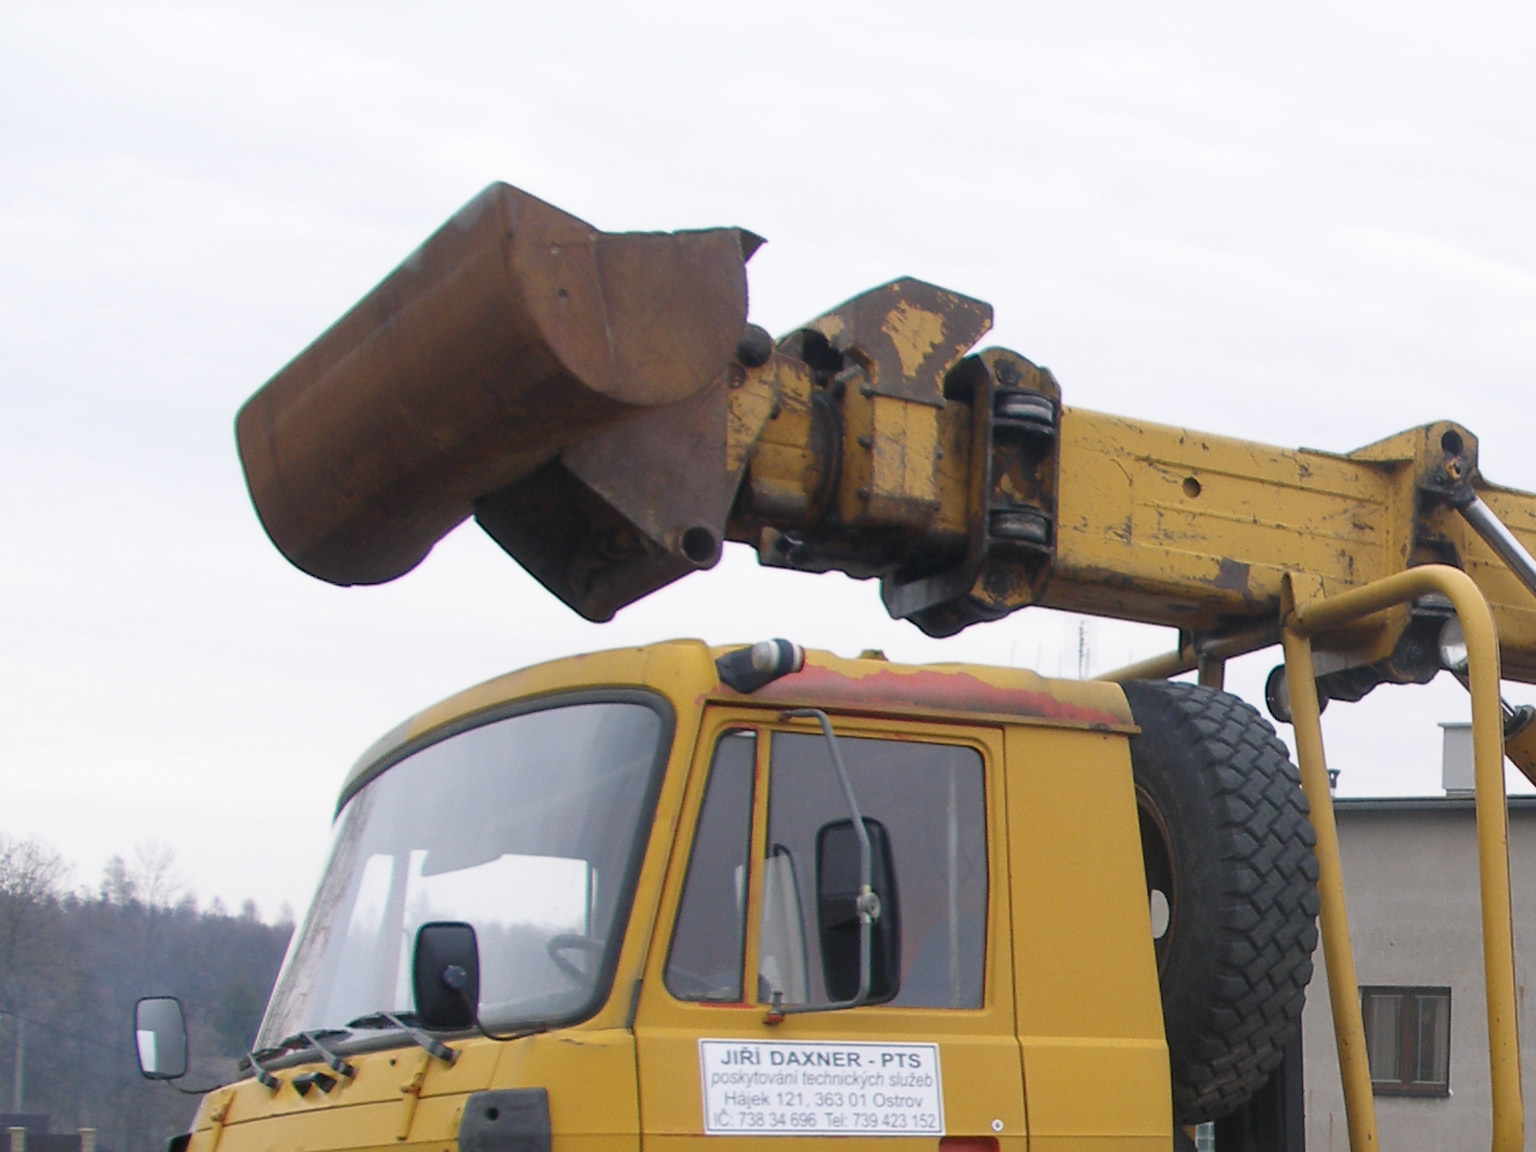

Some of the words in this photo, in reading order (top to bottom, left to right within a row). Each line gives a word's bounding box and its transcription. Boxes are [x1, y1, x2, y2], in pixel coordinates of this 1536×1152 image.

[720, 1046, 761, 1066] JIŘÍ
[770, 1050, 862, 1067] DAXNER
[881, 1052, 922, 1069] PTS
[711, 1069, 798, 1089] poskytování
[802, 1070, 885, 1090] technických
[889, 1072, 933, 1088] služeb
[724, 1090, 770, 1110] Hájek
[814, 1091, 844, 1108] 363
[848, 1091, 866, 1107] 01
[872, 1092, 924, 1108] Ostrov
[738, 1111, 765, 1128] 738
[768, 1112, 786, 1127] 34
[790, 1112, 817, 1128] 696
[853, 1112, 878, 1128] 739
[881, 1112, 908, 1129] 423
[911, 1112, 936, 1129] 152
